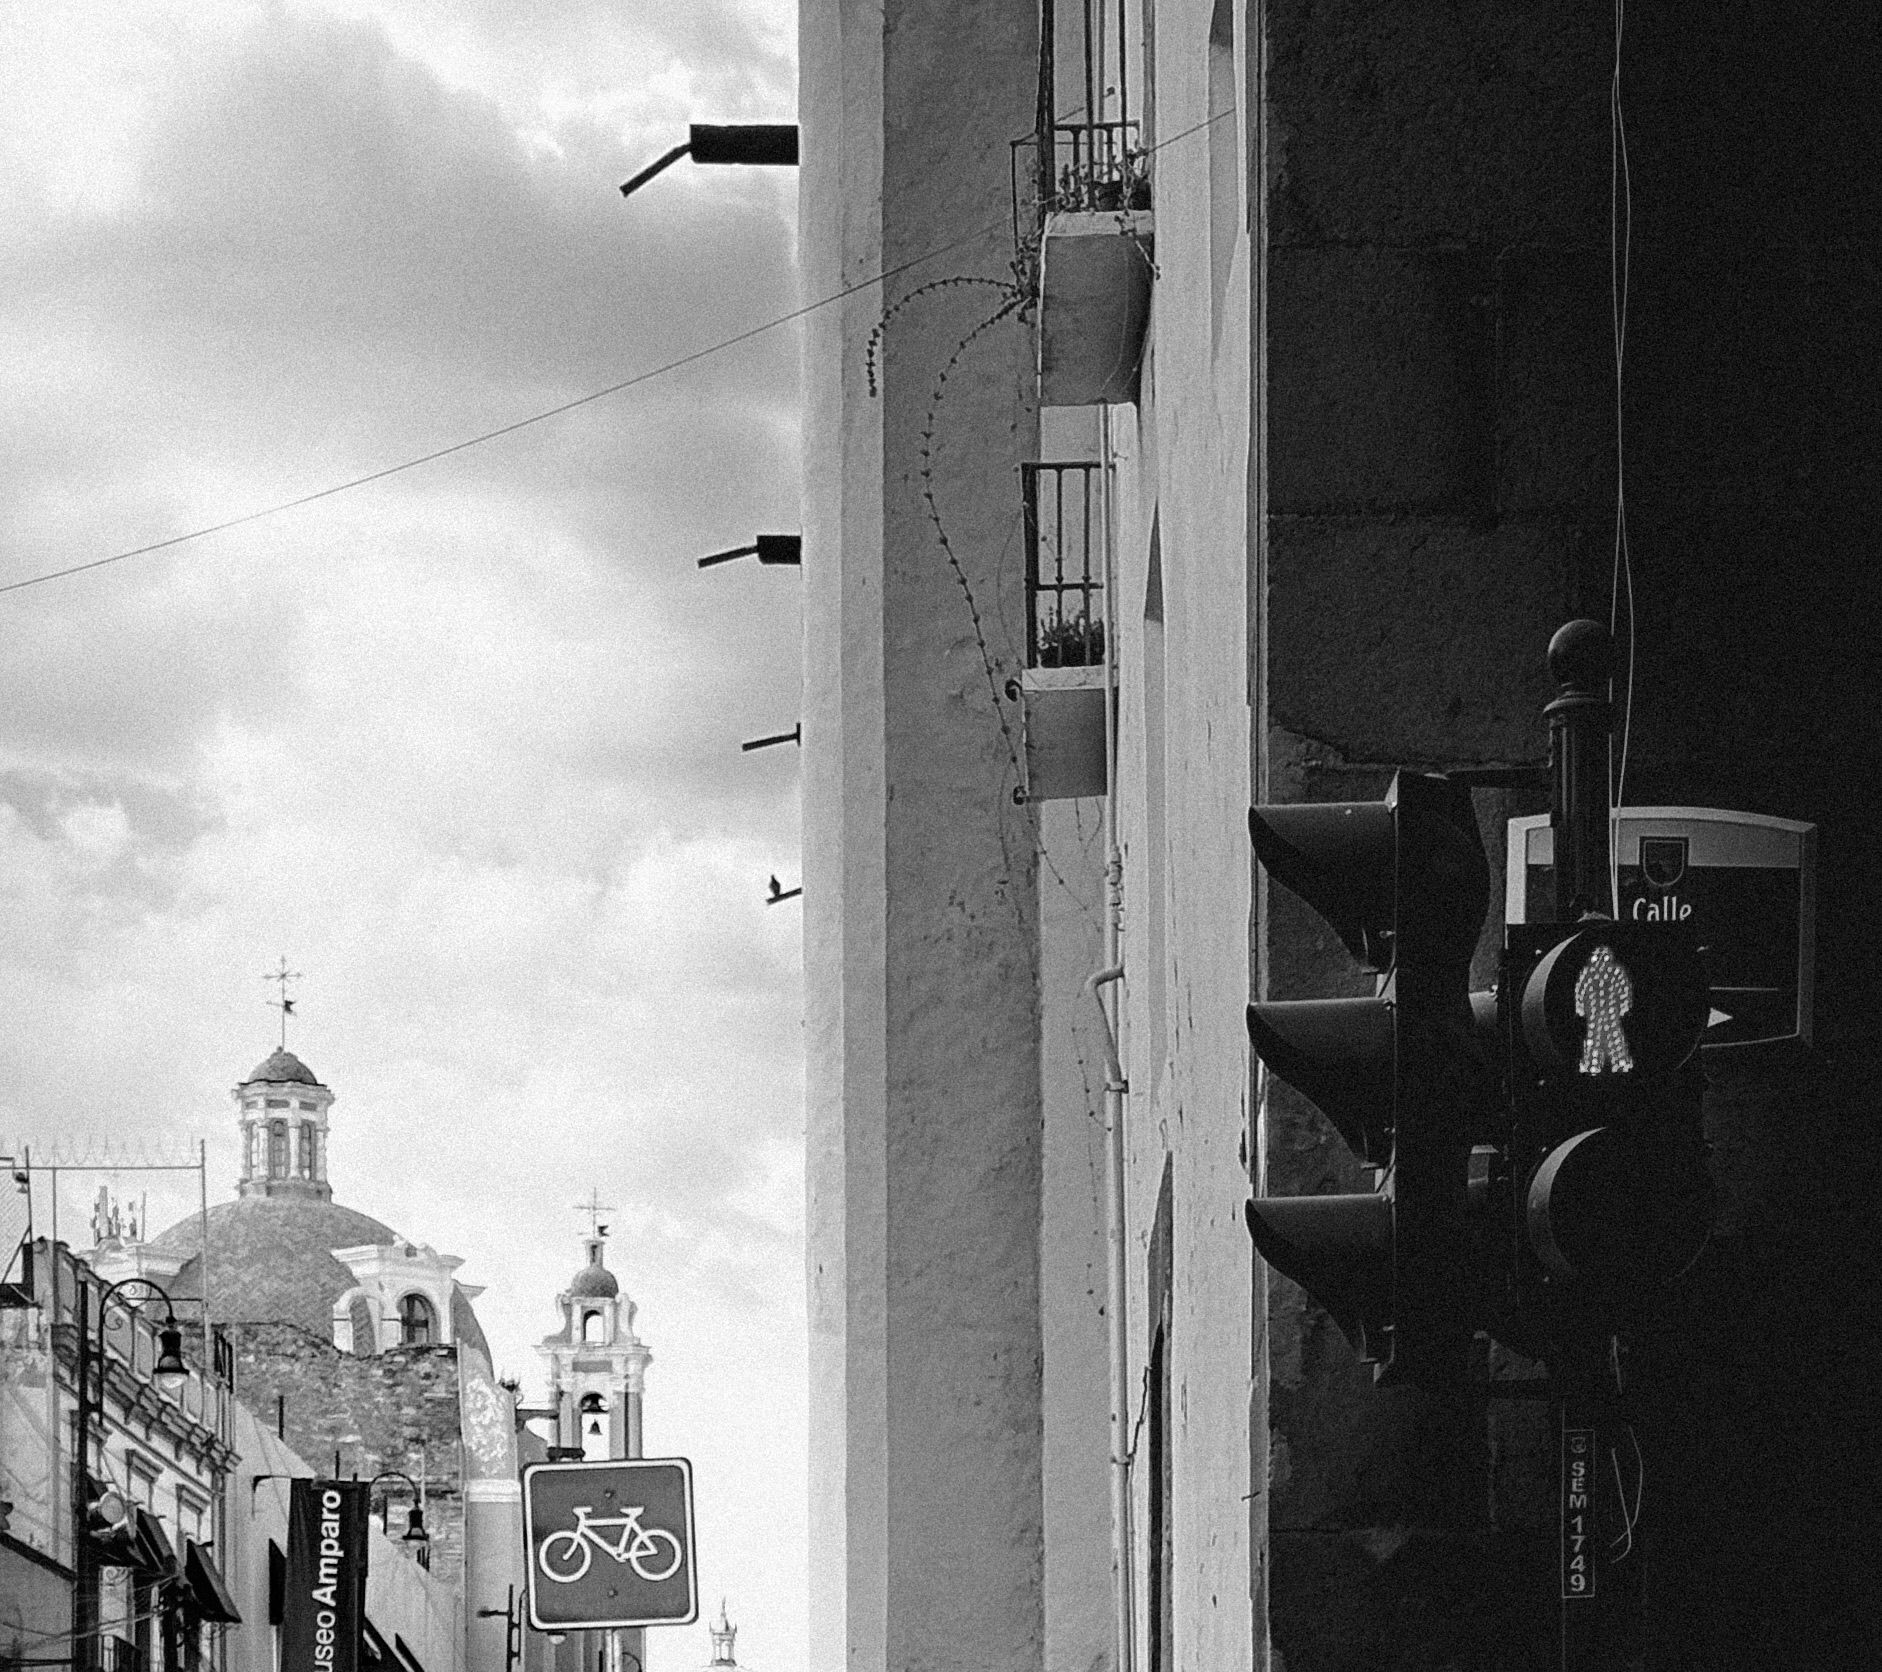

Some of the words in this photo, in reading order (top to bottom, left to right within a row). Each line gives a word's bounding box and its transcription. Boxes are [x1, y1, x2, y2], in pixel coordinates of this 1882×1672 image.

[1631, 895, 1693, 921] Calle
[1569, 1461, 1587, 1509] SEM
[311, 1489, 345, 1608] Amparo
[1569, 1515, 1587, 1593] 1749
